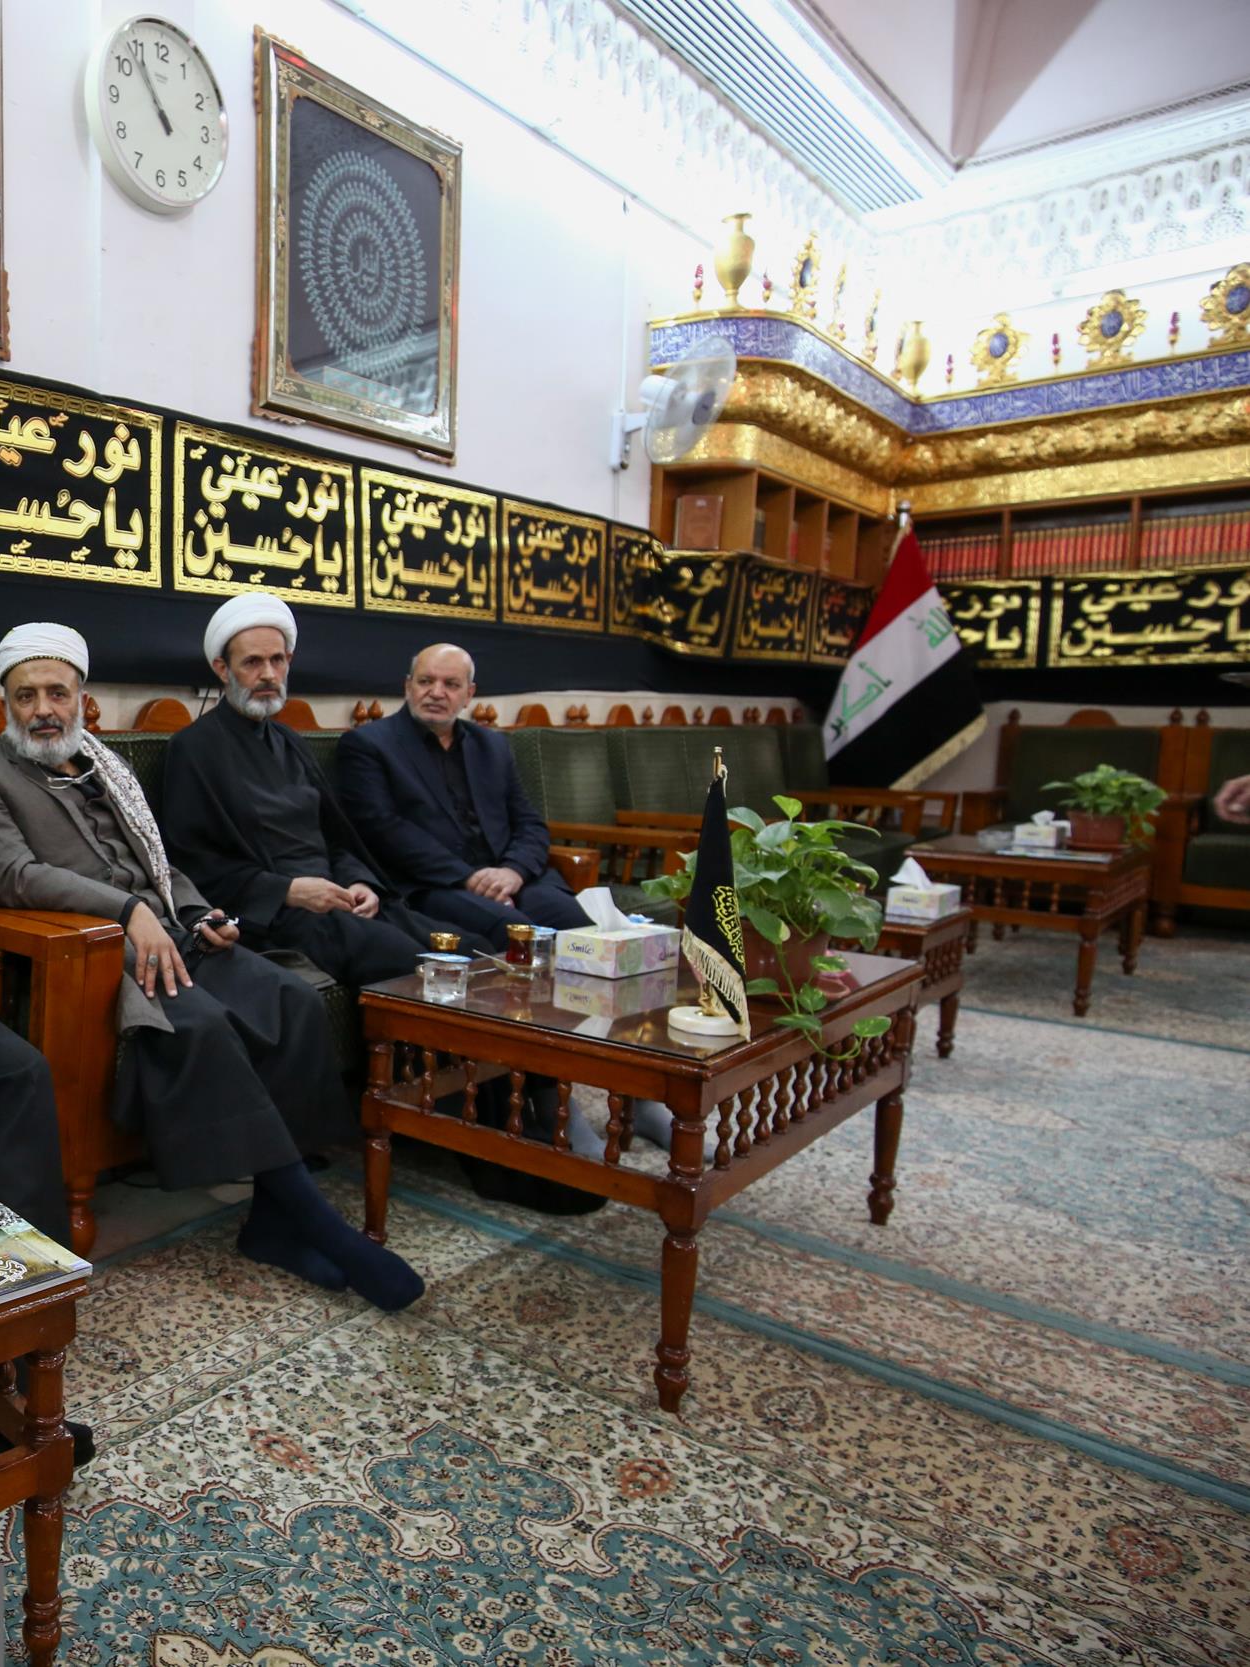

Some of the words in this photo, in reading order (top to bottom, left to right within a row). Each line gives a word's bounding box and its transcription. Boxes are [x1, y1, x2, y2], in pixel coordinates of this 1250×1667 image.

[132, 39, 145, 63] 11
[154, 41, 170, 64] 12
[115, 55, 133, 76] 10
[180, 63, 187, 80] 1
[109, 84, 120, 104] 9
[195, 93, 205, 111] 2
[116, 121, 127, 140] 8
[201, 126, 210, 144] 3
[134, 151, 144, 169] 7
[193, 155, 203, 171] 4
[156, 169, 166, 188] 6
[178, 170, 188, 188] 5
[63, 423, 141, 483] نور
[201, 454, 283, 520] عيني
[285, 472, 340, 523] نور
[104, 487, 144, 569] يا
[381, 492, 442, 548] عيني
[444, 505, 486, 548] نور
[314, 524, 343, 593] يا
[1187, 578, 1250, 609] ور
[569, 942, 594, 955] Smile
